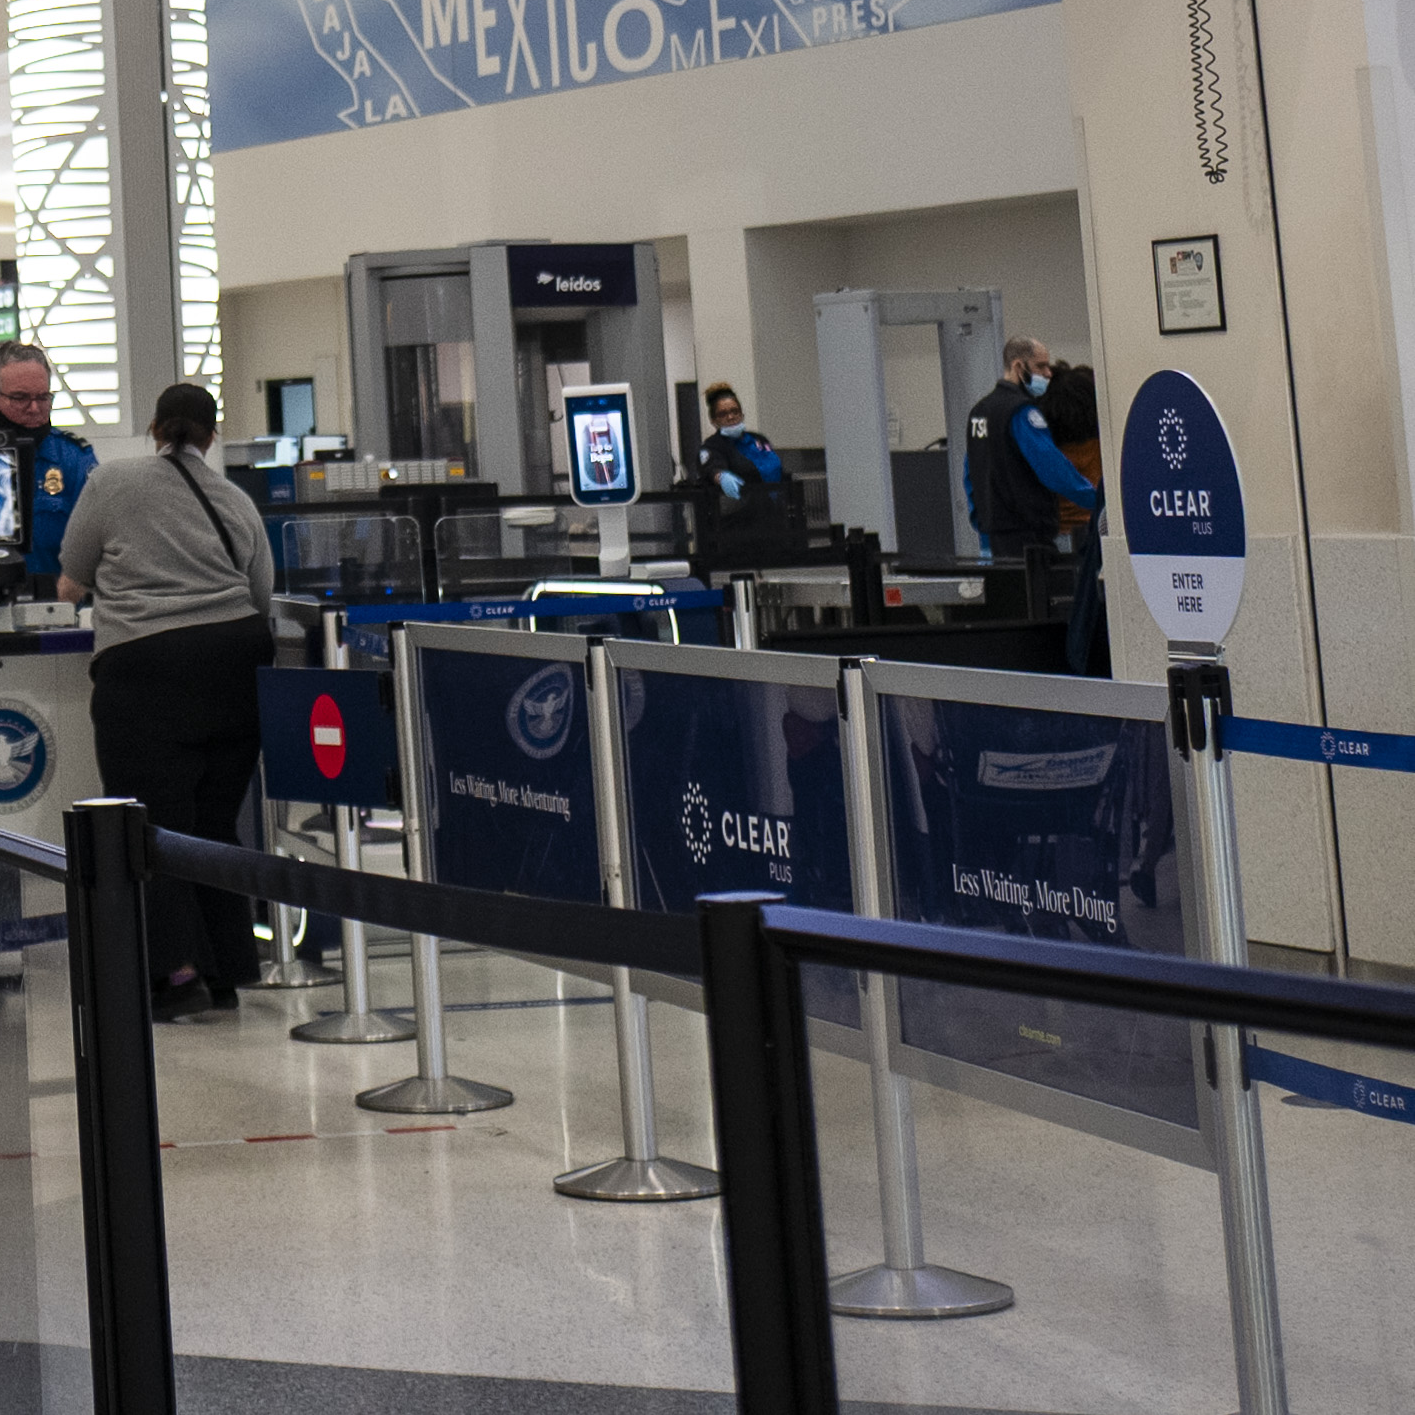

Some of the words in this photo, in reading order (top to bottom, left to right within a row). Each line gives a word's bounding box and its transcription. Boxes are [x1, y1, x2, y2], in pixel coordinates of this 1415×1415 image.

[555, 275, 602, 292] leidos
[1150, 489, 1211, 517] CLEAR
[1192, 521, 1214, 535] PLUS
[1172, 572, 1204, 590] ENTER
[485, 606, 514, 616] CLEAR
[649, 598, 676, 608] CLEAR
[1177, 595, 1204, 613] HERE
[1338, 740, 1370, 757] CLEAR
[450, 771, 467, 796] Less
[498, 780, 519, 806] More
[520, 784, 571, 822] Adventuring
[721, 810, 791, 859] CLEAR
[769, 862, 793, 884] PLUS
[952, 863, 980, 897] Less
[980, 869, 1034, 916] Waiting,
[1035, 879, 1071, 916] More
[1072, 886, 1118, 934] Doing
[1369, 1091, 1407, 1111] CLEAR
